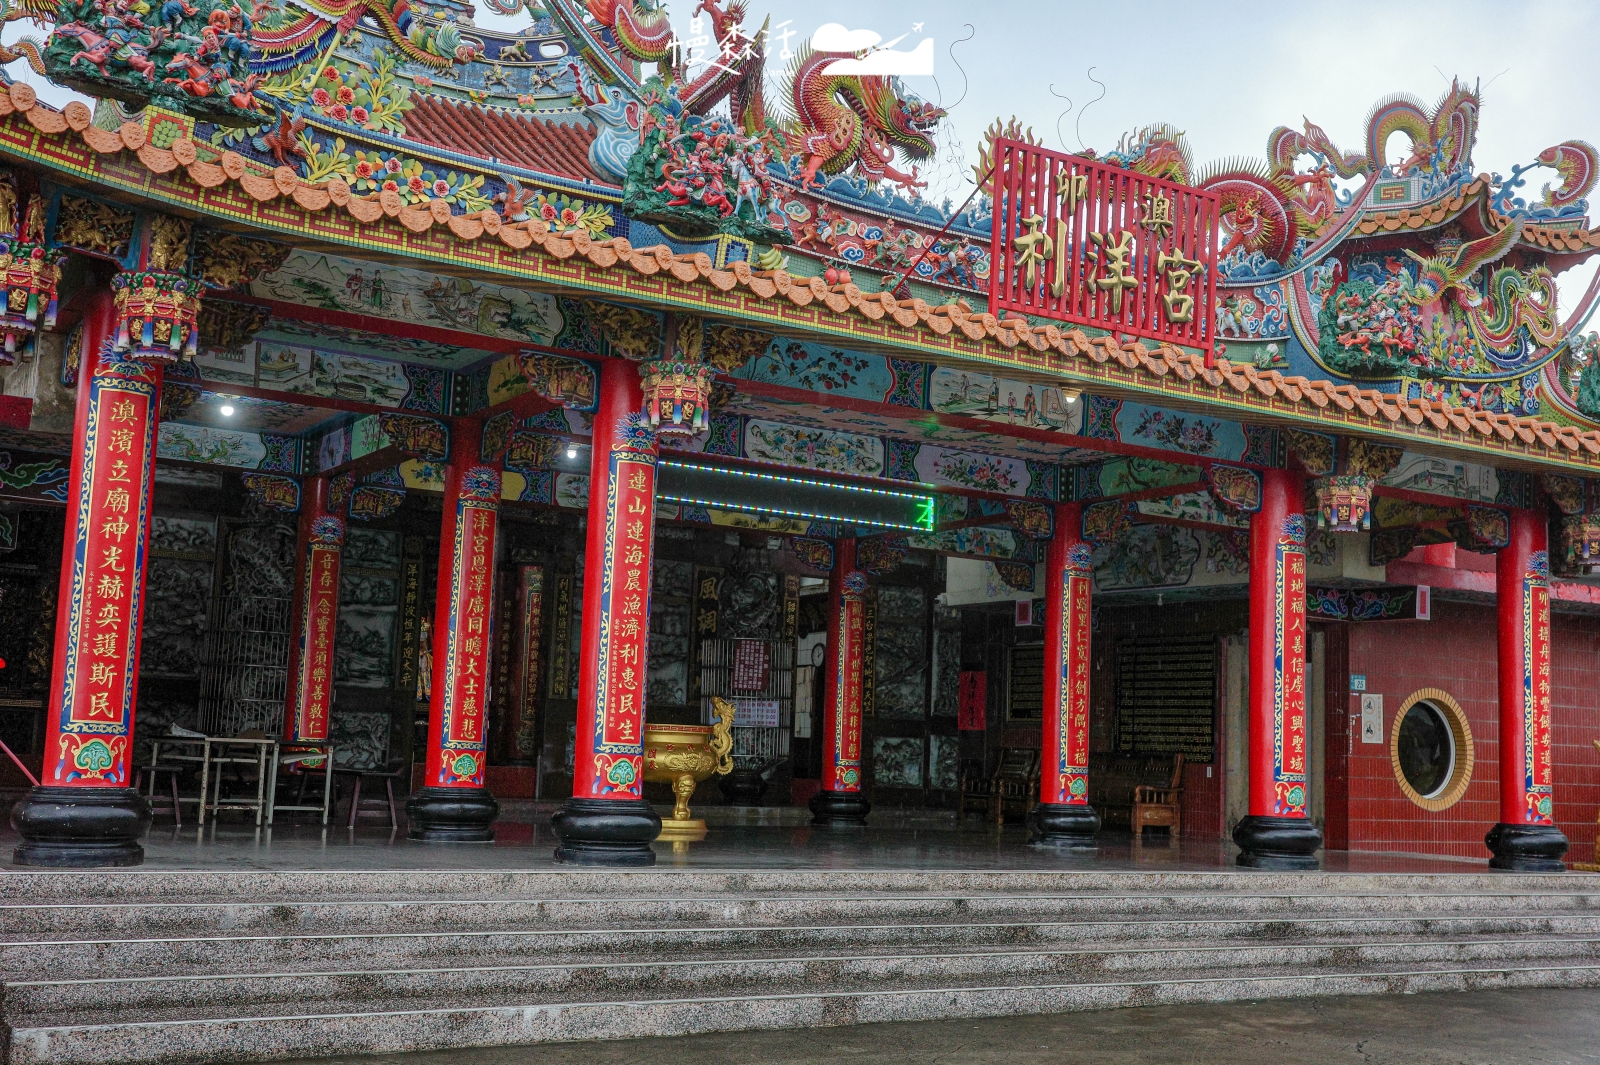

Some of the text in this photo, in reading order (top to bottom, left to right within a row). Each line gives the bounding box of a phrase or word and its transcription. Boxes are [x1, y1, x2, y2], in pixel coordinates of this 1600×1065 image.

[1012, 213, 1205, 323] 利洋宮
[88, 398, 138, 719] 澳濱立廟神光赫奕護斯民
[459, 512, 491, 740] 洋宮恩澤廣同瞻大士慈悲
[617, 468, 648, 741] 連山連海農漁濟利惠民生
[1289, 557, 1305, 773] 福地福人善信虔心興聖域
[1356, 680, 1364, 689] 25
